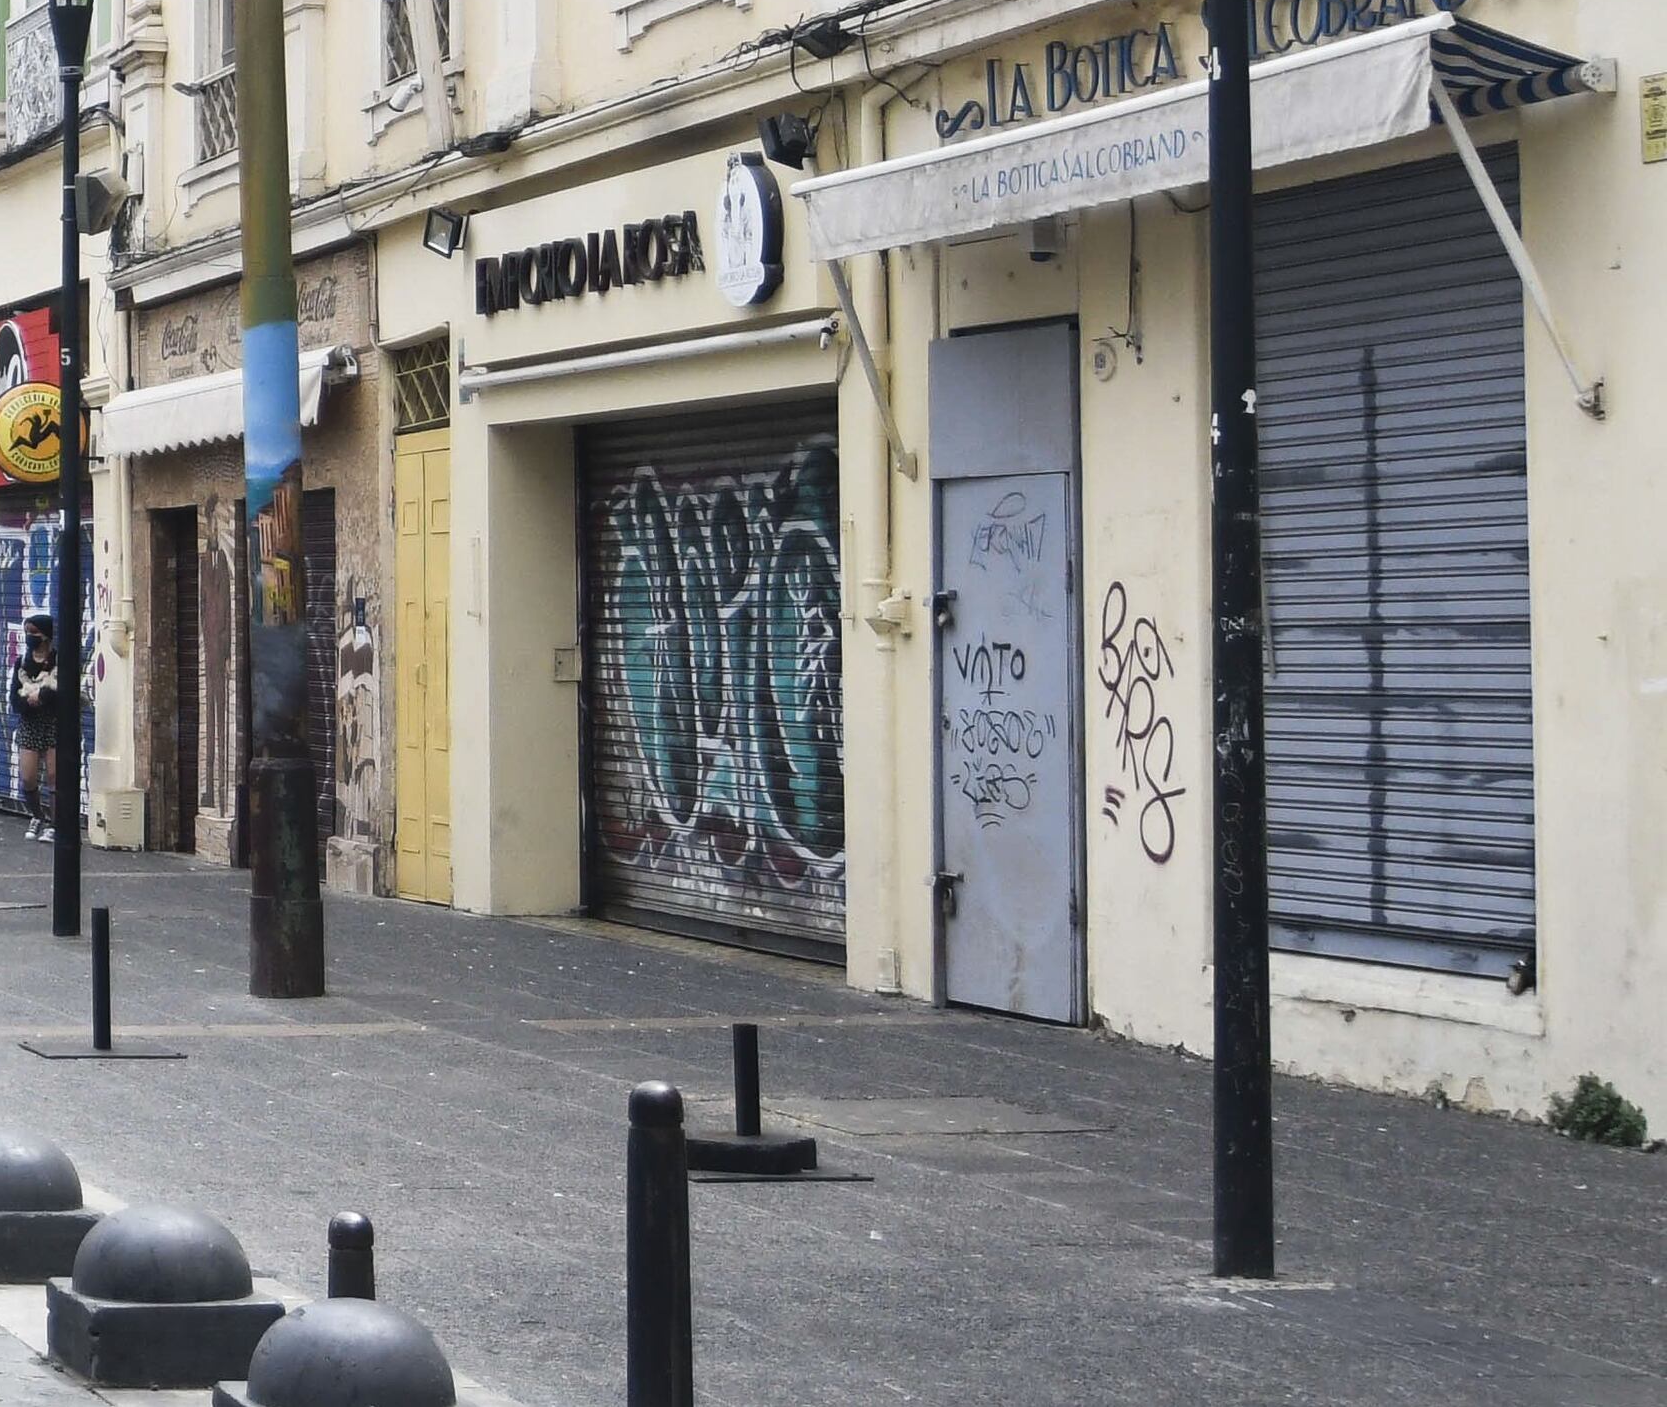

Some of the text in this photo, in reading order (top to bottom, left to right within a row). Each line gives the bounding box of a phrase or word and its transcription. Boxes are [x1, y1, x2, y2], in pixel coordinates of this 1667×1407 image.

[985, 21, 1182, 127] LA BOTICA
[971, 172, 990, 204] LA
[587, 228, 623, 294] LA
[60, 348, 72, 366] 5
